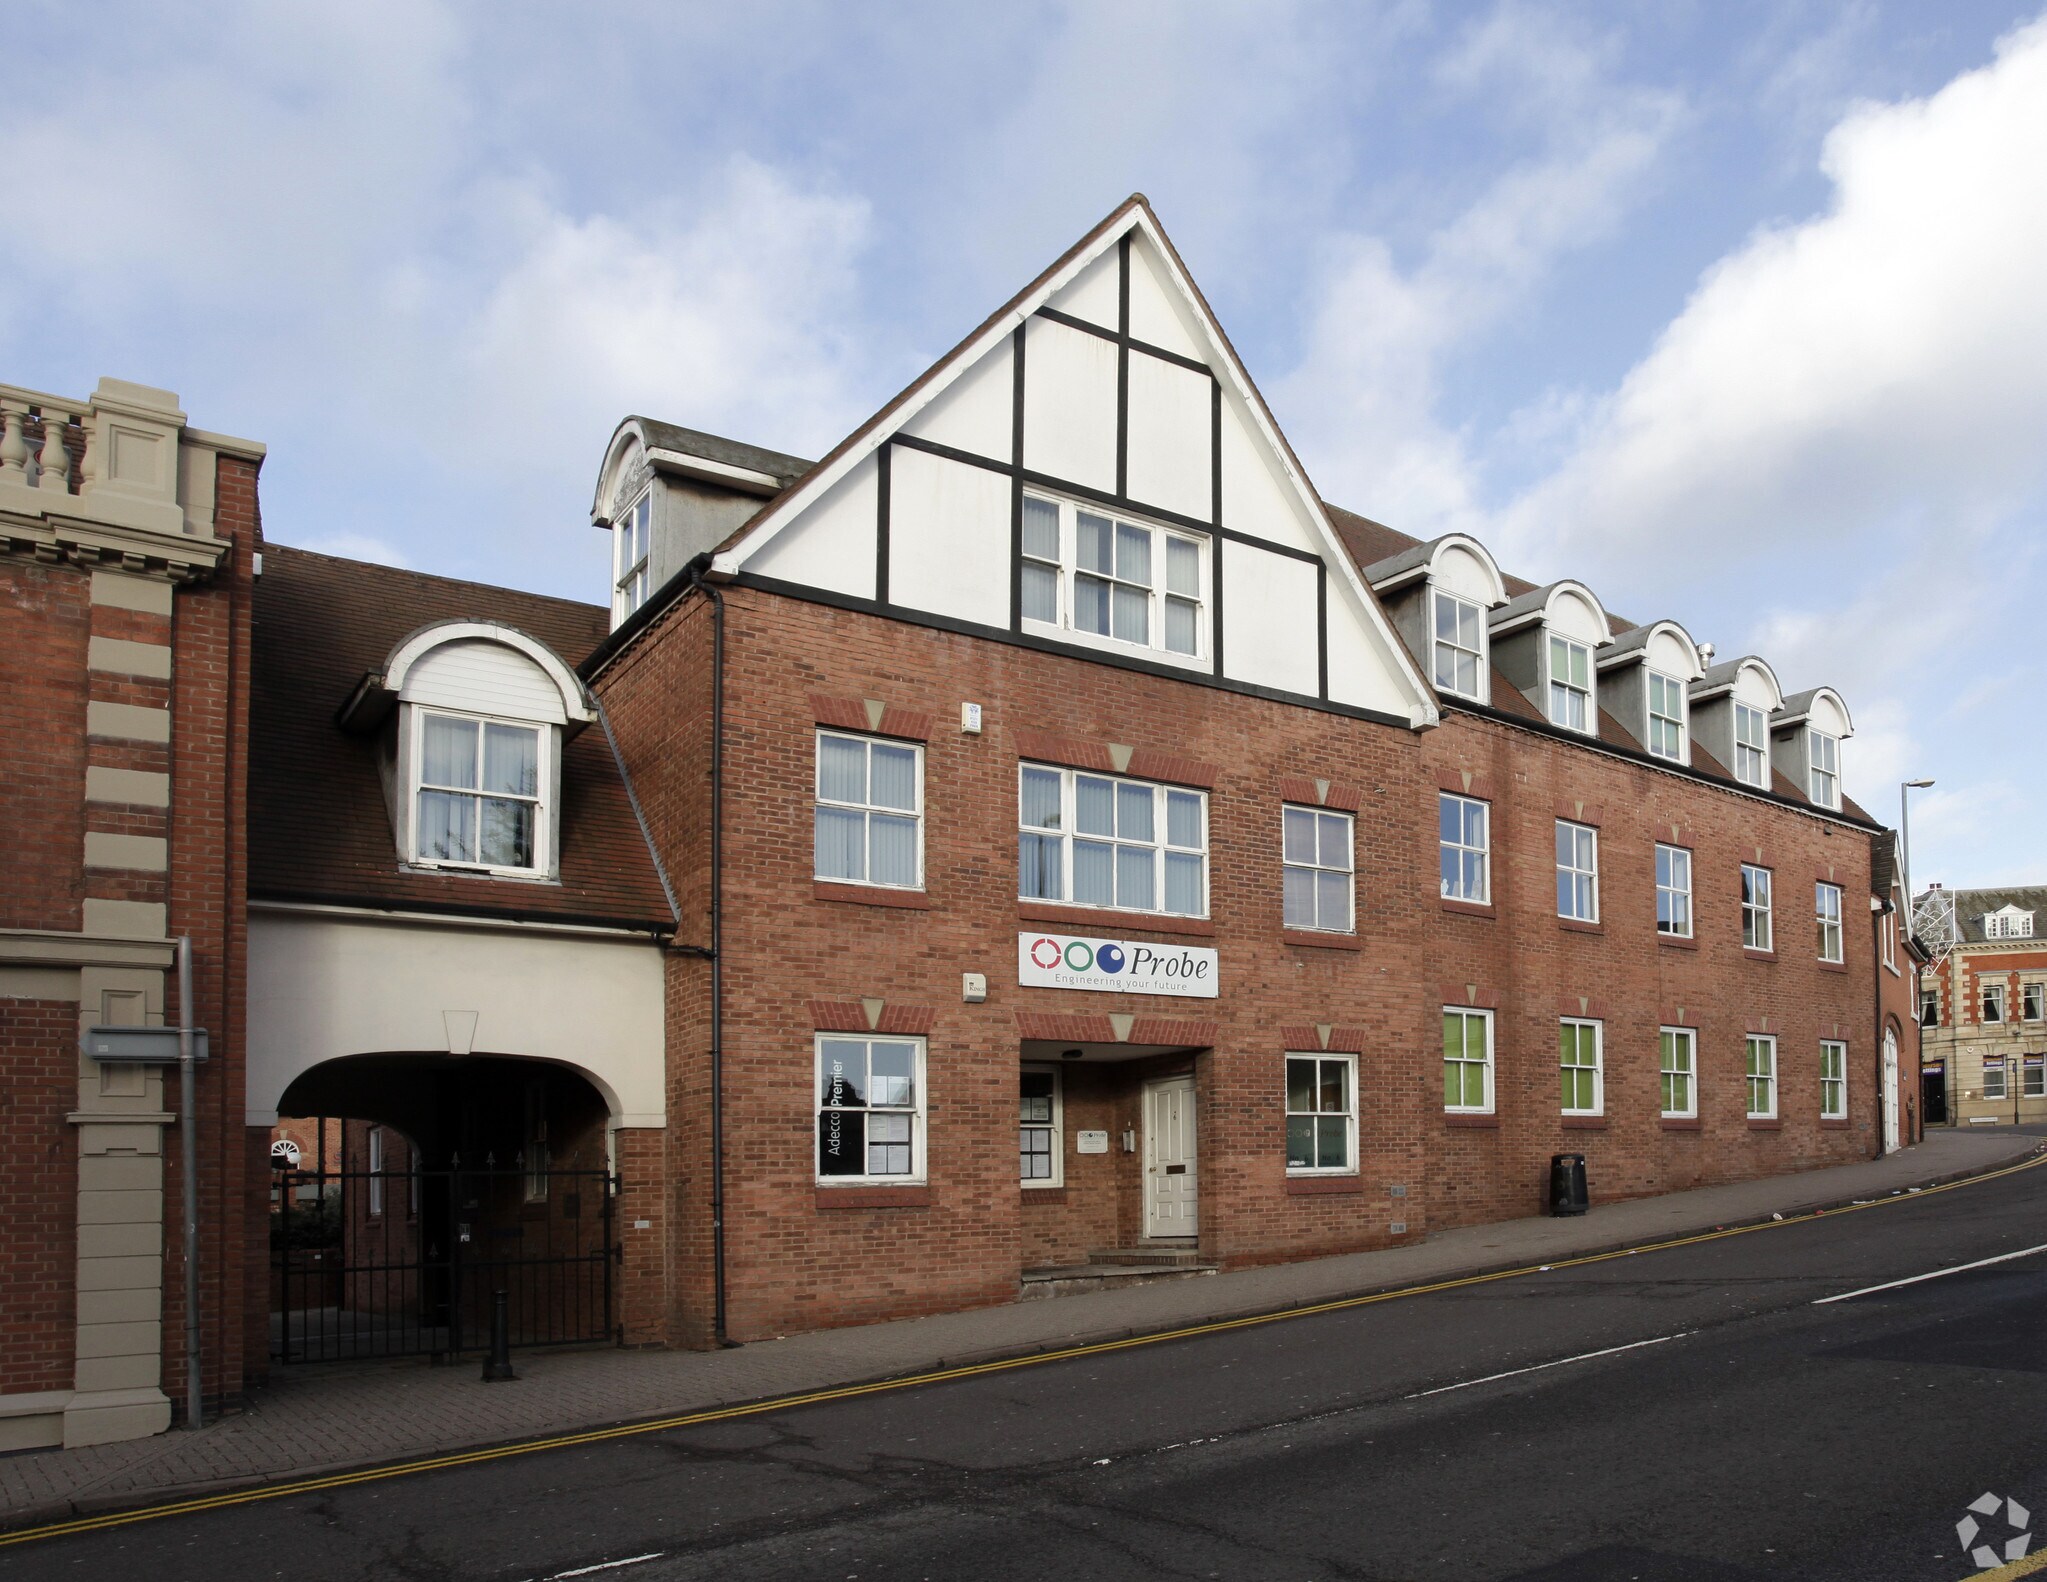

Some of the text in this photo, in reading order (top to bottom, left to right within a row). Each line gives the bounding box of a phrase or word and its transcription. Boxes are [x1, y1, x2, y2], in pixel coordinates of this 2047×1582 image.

[1129, 947, 1209, 980] Probe
[1055, 973, 1188, 991] Engineering your future
[828, 1060, 842, 1155] Adecco Premier
